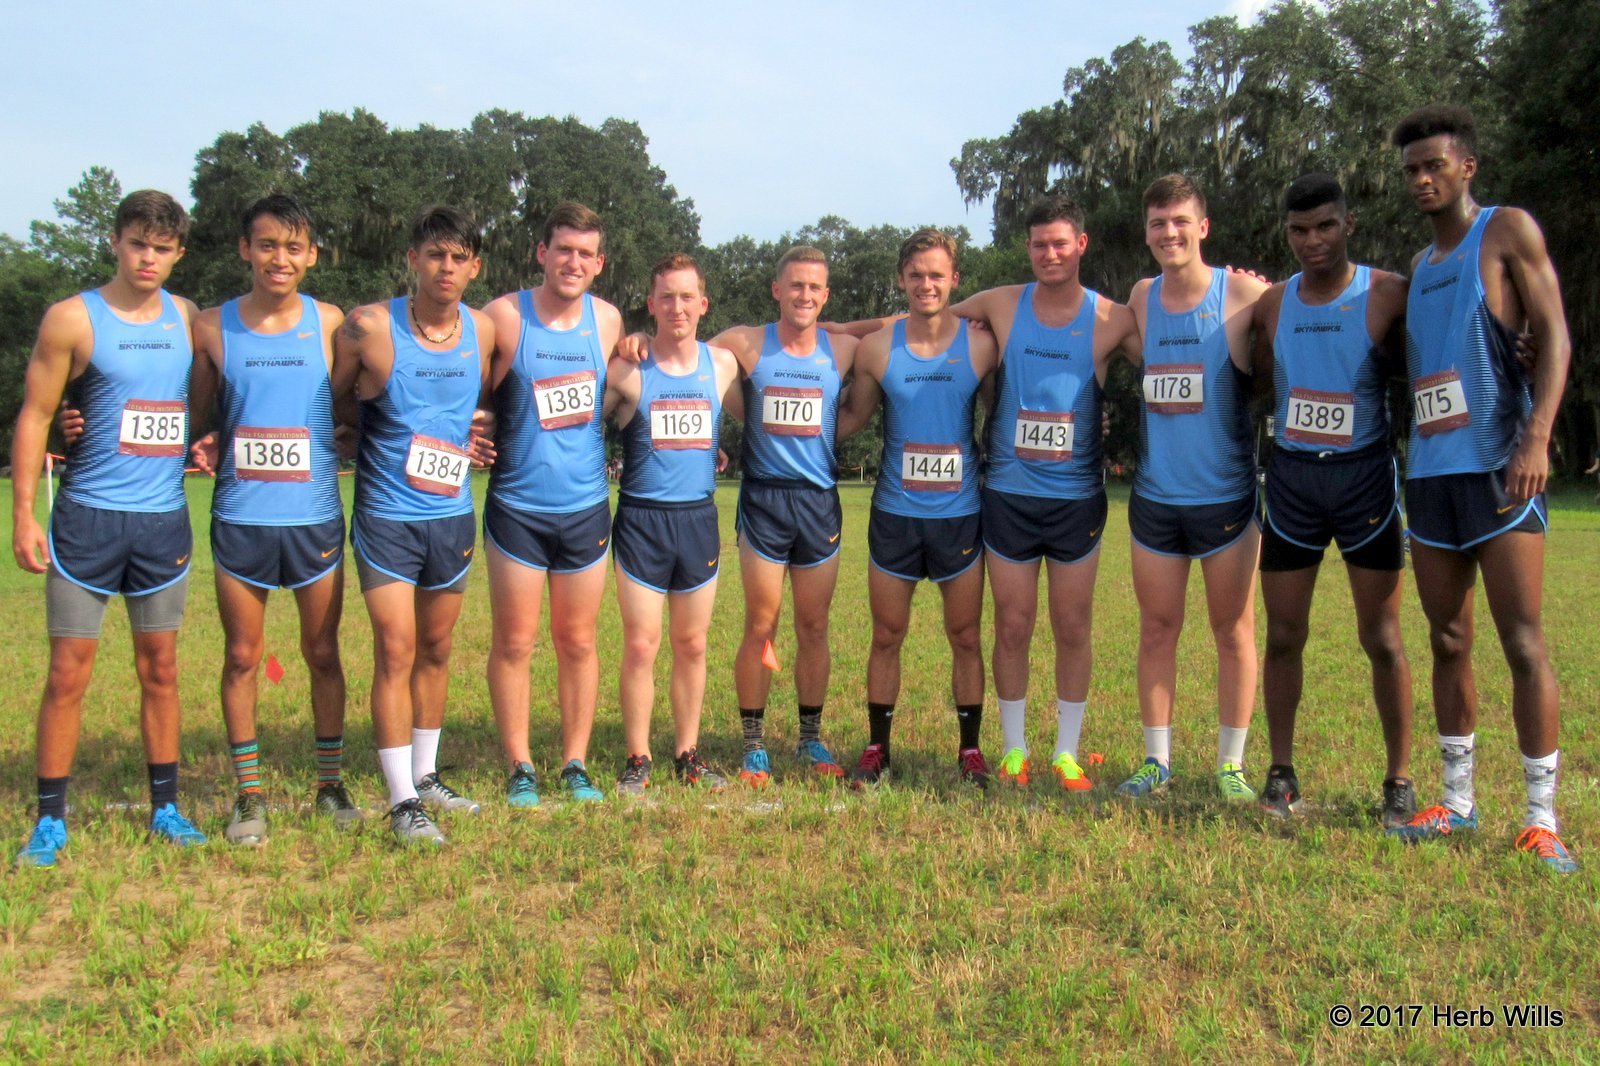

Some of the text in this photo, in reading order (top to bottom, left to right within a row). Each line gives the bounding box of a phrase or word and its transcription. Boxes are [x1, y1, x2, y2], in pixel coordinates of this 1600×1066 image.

[1294, 325, 1341, 333] SKYHAWKS
[1159, 338, 1200, 346] SKYHAWKS
[536, 352, 586, 362] SKYHAWKS
[1024, 348, 1069, 360] SKYHAWKS
[774, 372, 820, 381] SKYHAWKS
[904, 375, 952, 383] SKYHAWKS
[1152, 377, 1191, 399] 1178
[544, 385, 593, 414] 1383
[773, 400, 813, 422] 1170
[1295, 403, 1345, 430] 1389
[132, 415, 180, 441] 1385
[662, 413, 702, 435] 1169
[1022, 423, 1066, 447] 1443
[244, 442, 301, 467] 1386
[417, 450, 462, 482] 1384
[909, 456, 955, 478] 1444
